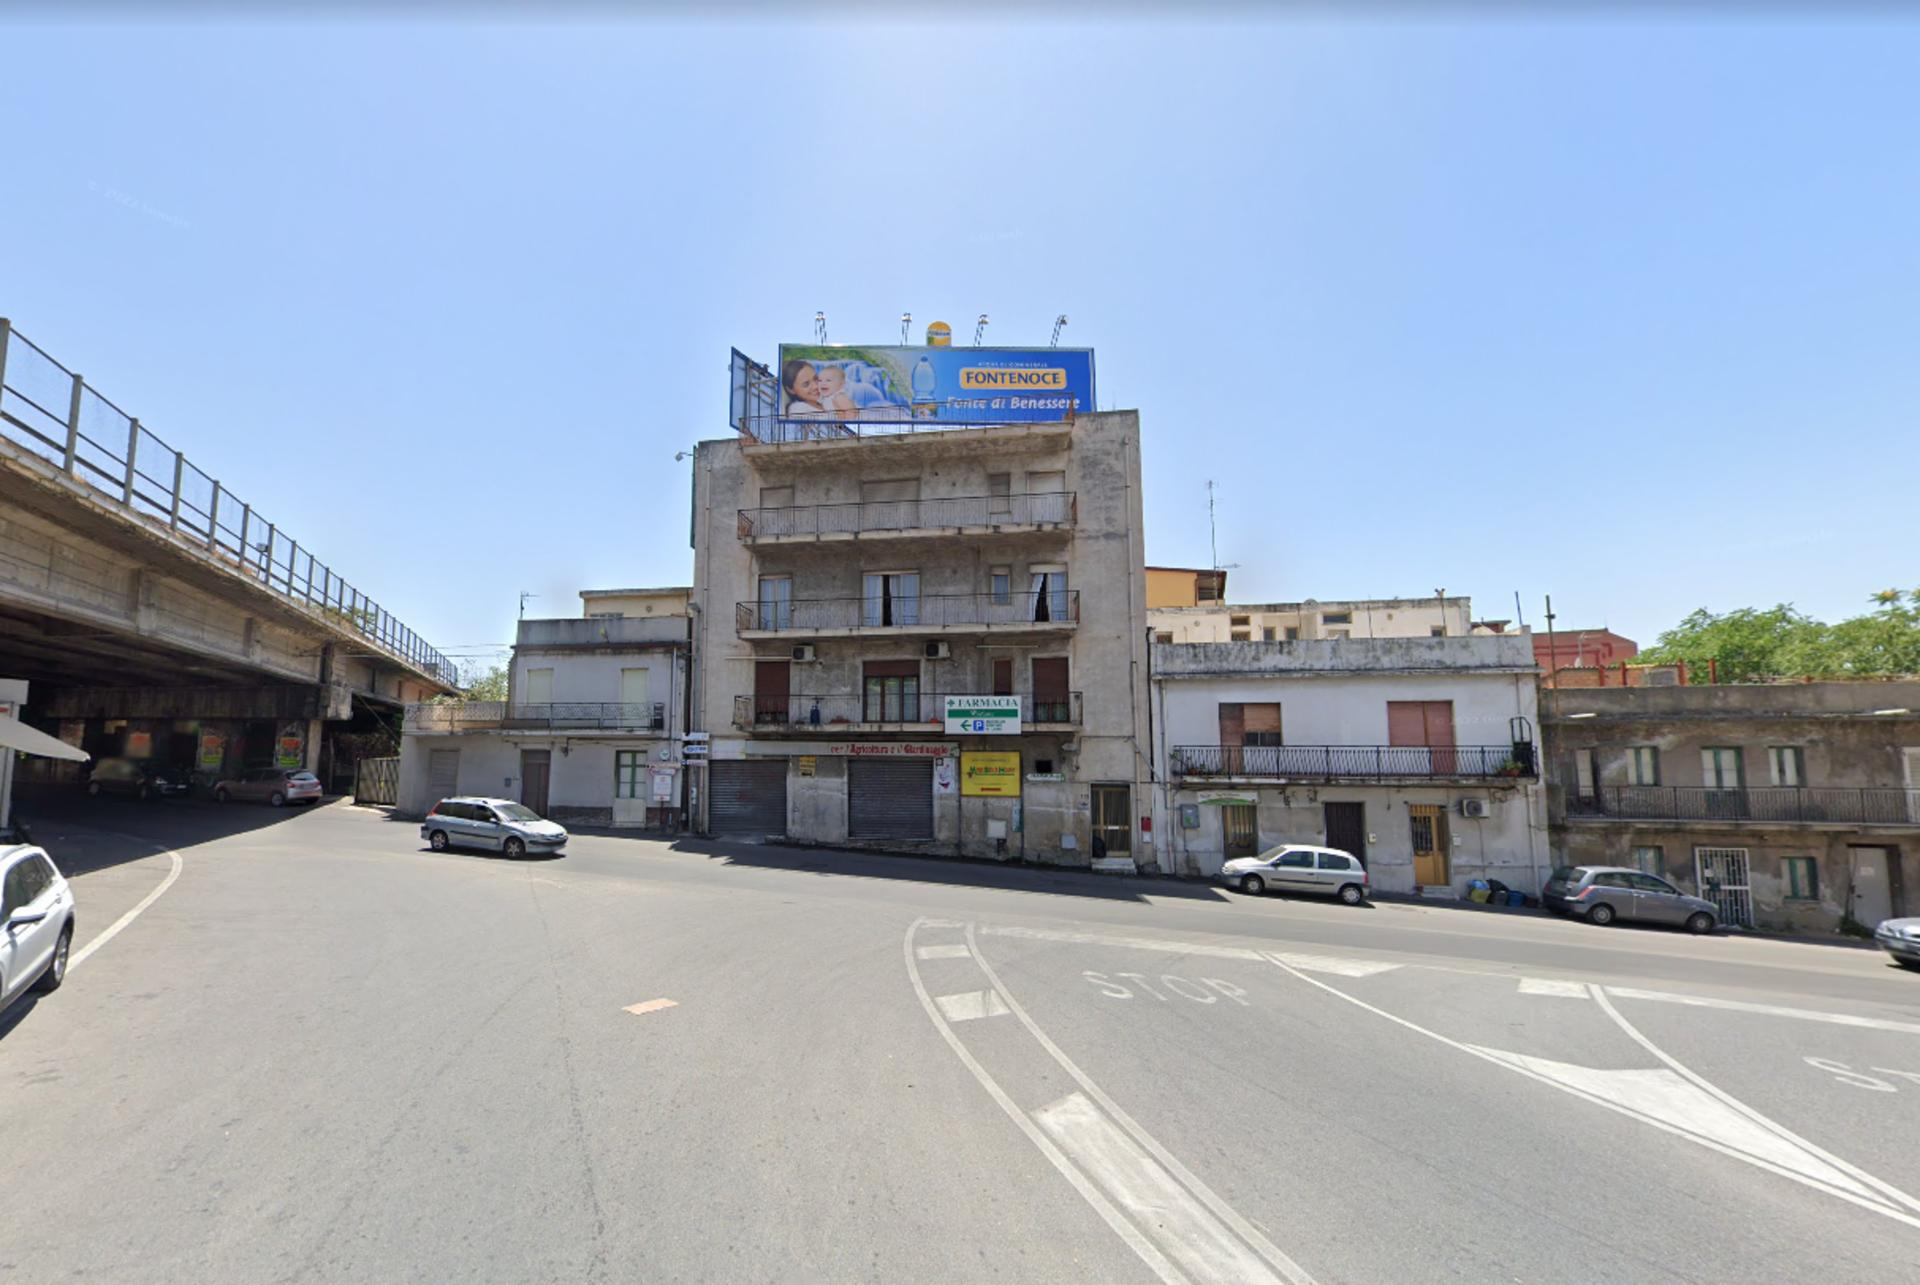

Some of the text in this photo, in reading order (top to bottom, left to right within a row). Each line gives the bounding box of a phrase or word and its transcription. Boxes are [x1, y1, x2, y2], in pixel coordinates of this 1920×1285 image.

[966, 371, 1061, 385] FONTENOCE
[947, 396, 1081, 409] Fonte di Benessere
[958, 698, 1018, 707] FARMACIA
[1081, 970, 1251, 1006] STOP
